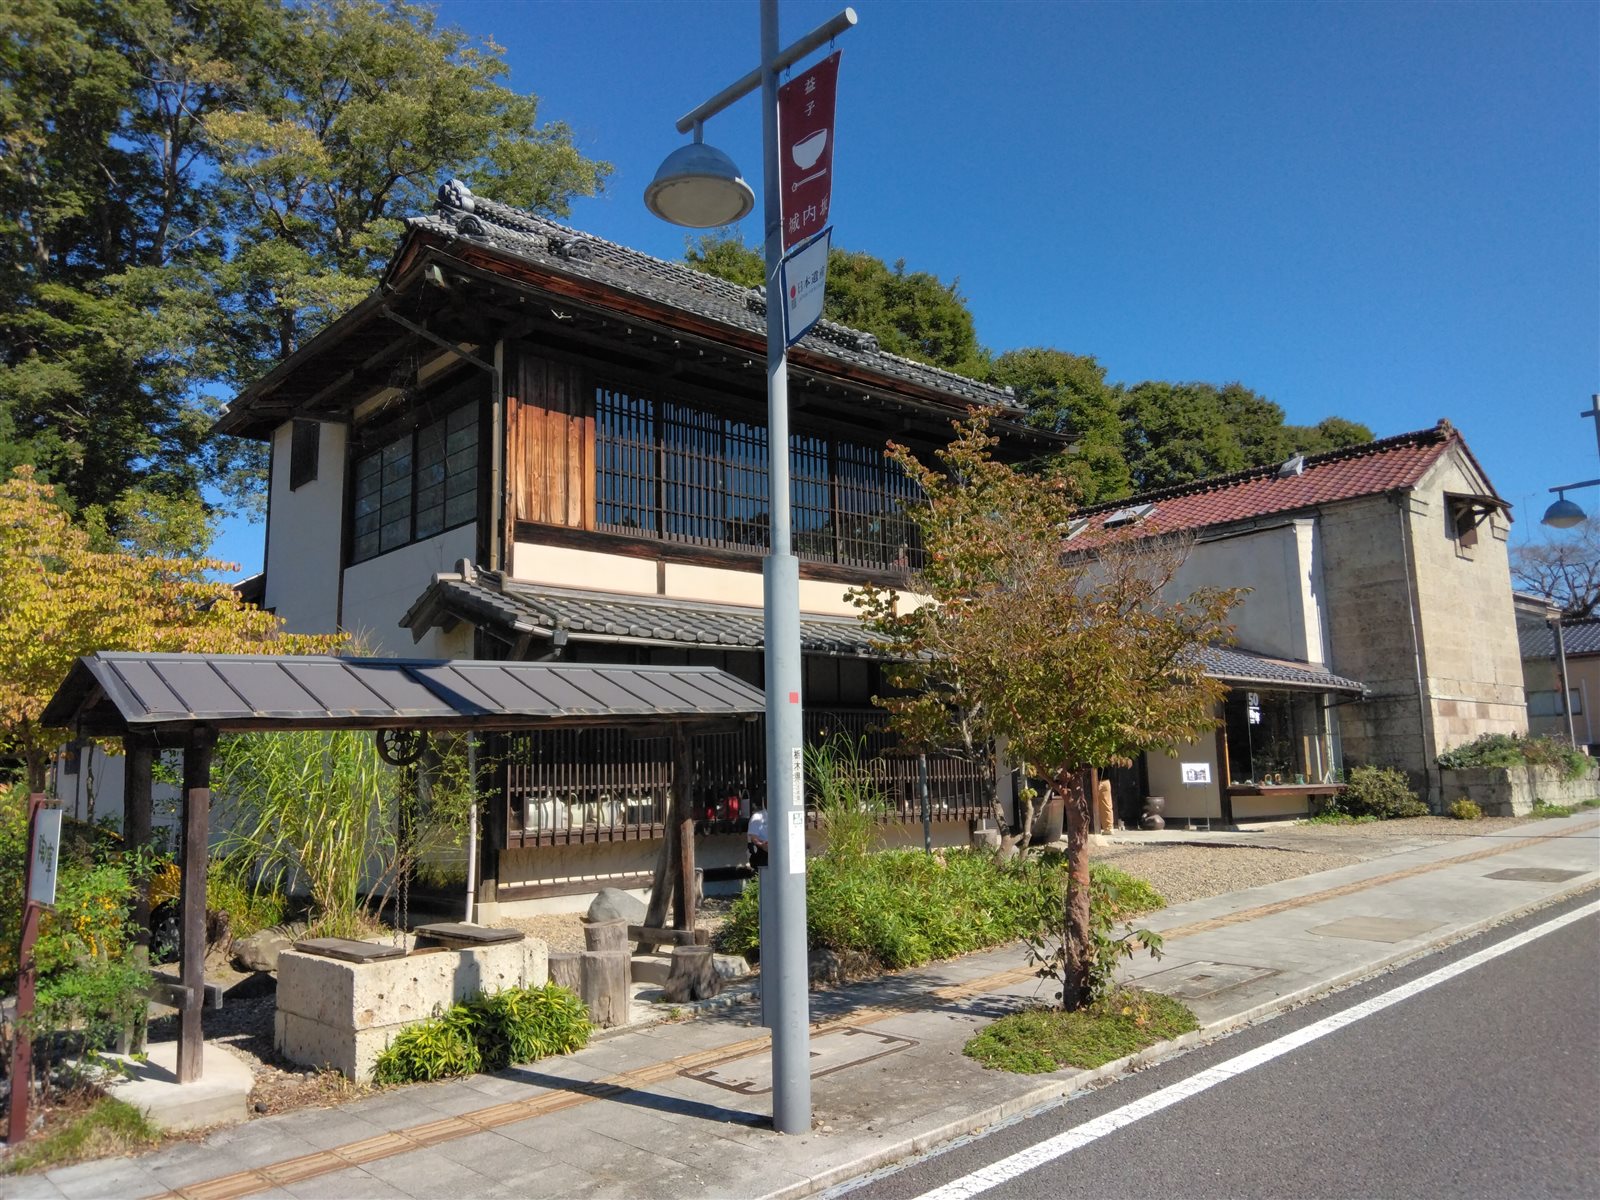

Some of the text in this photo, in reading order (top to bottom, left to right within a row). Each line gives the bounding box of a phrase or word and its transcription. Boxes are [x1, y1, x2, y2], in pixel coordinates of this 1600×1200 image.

[803, 76, 816, 117] 益子
[788, 192, 829, 234] 城内坂
[1248, 692, 1259, 707] 50
